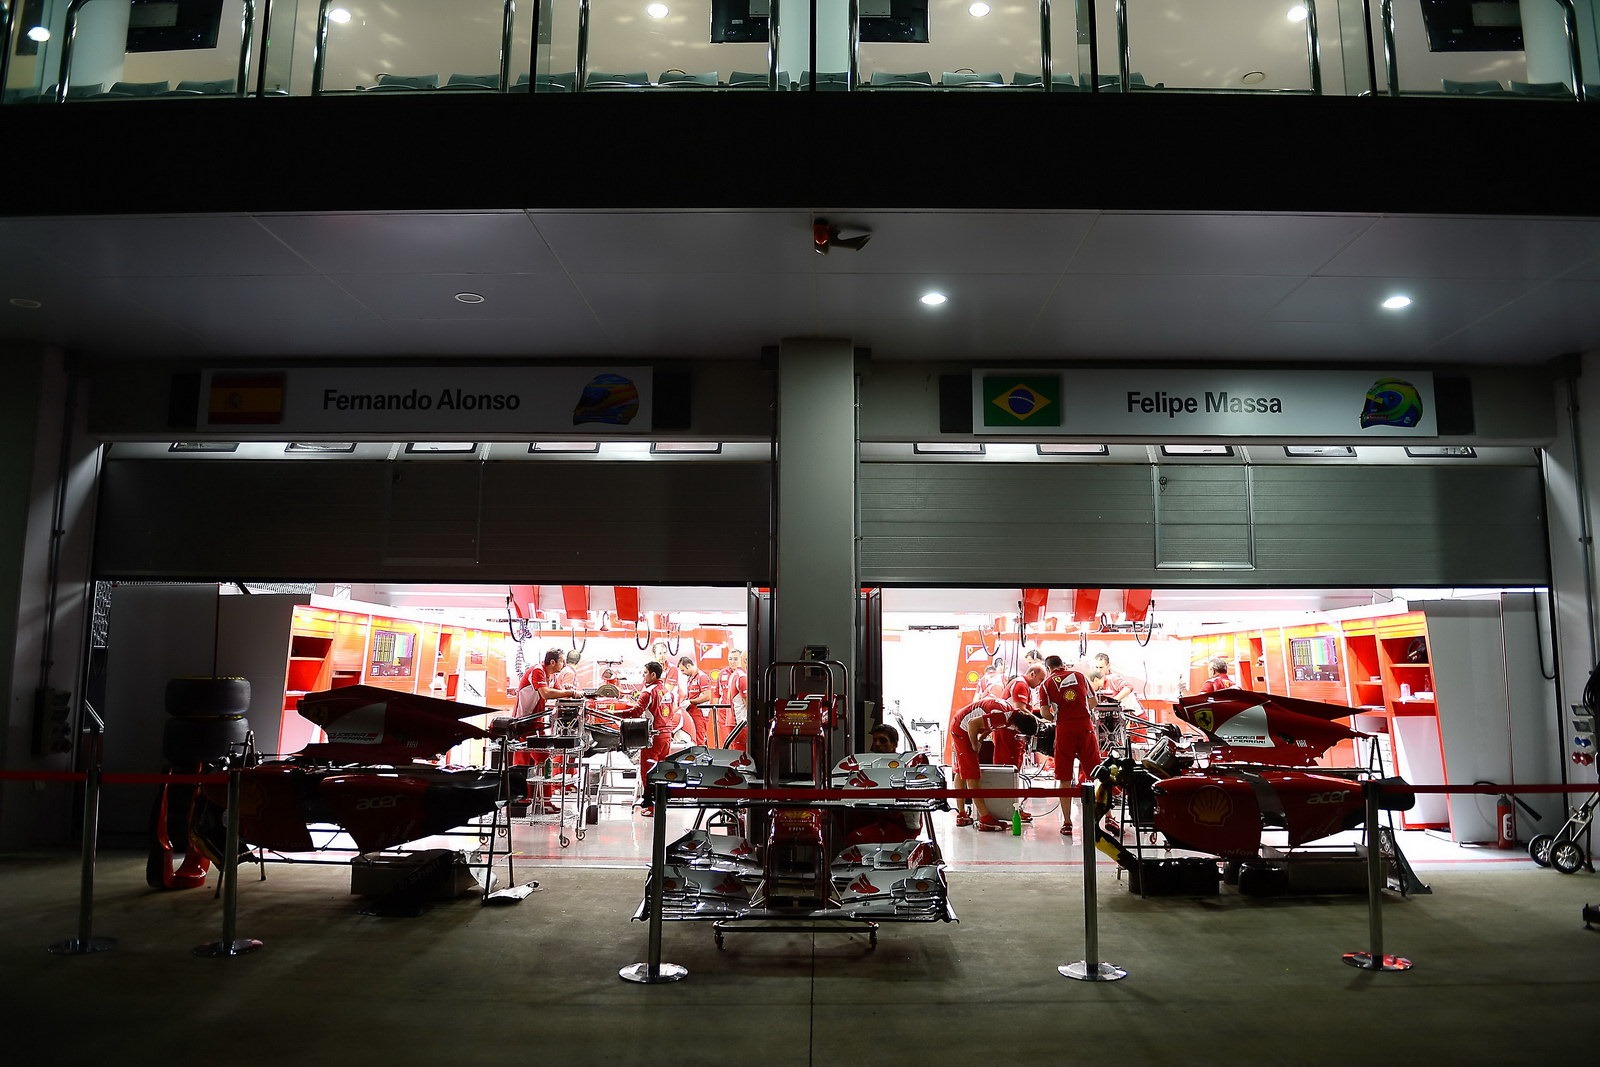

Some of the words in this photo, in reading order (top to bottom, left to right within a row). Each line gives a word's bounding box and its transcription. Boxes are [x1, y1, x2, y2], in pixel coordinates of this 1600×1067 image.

[323, 389, 432, 410] Fernando
[436, 389, 520, 410] Alonso
[1127, 391, 1198, 418] Felipe
[1204, 391, 1282, 413] Massa
[784, 700, 811, 711] 5
[355, 793, 405, 810] acer
[1307, 789, 1350, 804] acer
